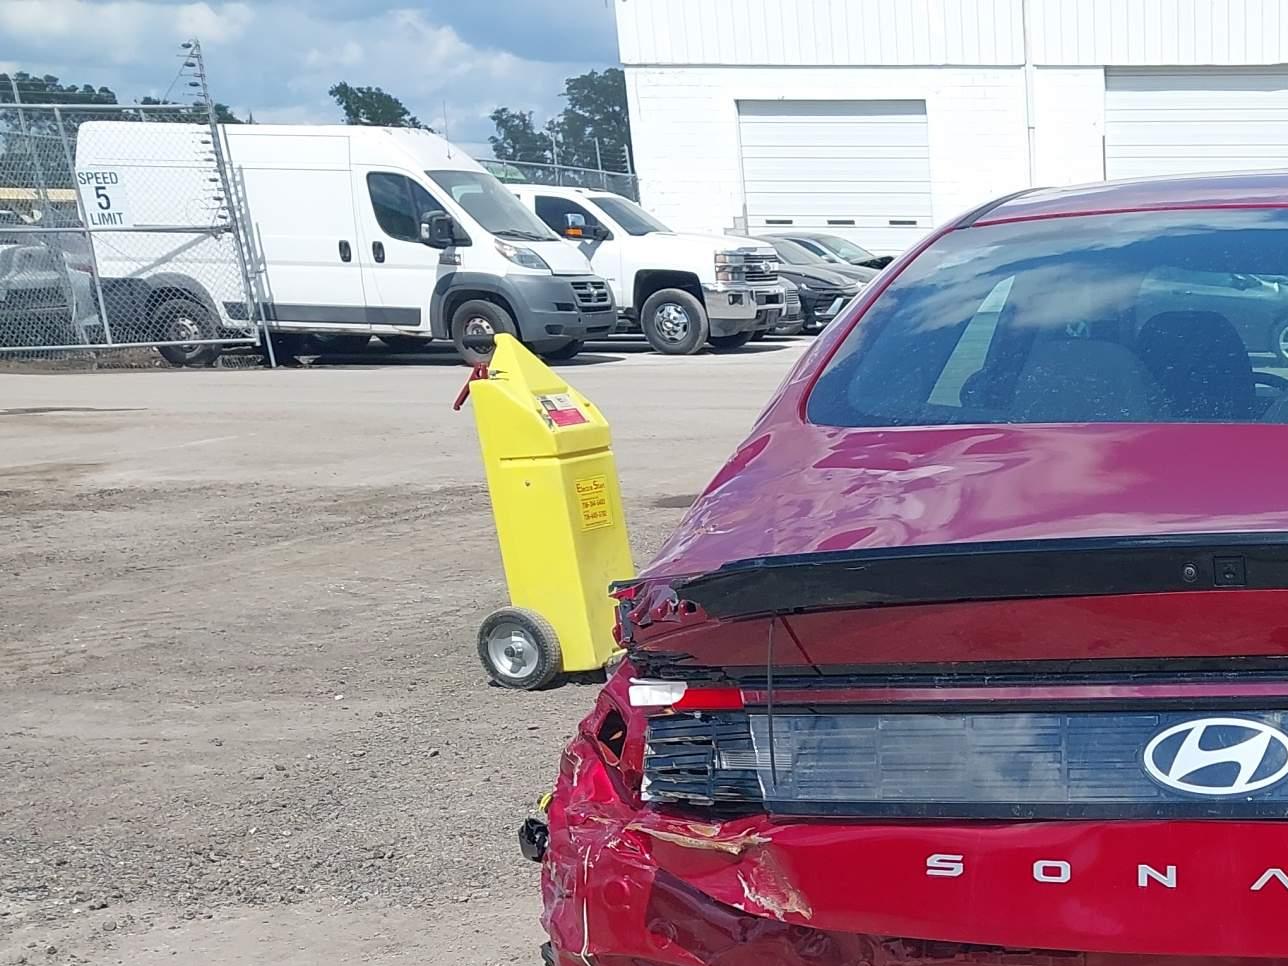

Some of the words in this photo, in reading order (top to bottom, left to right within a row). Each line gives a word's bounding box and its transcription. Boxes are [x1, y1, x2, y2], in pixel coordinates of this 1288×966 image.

[78, 171, 118, 185] SPEED
[95, 186, 111, 210] 5
[90, 212, 124, 226] LIMIT
